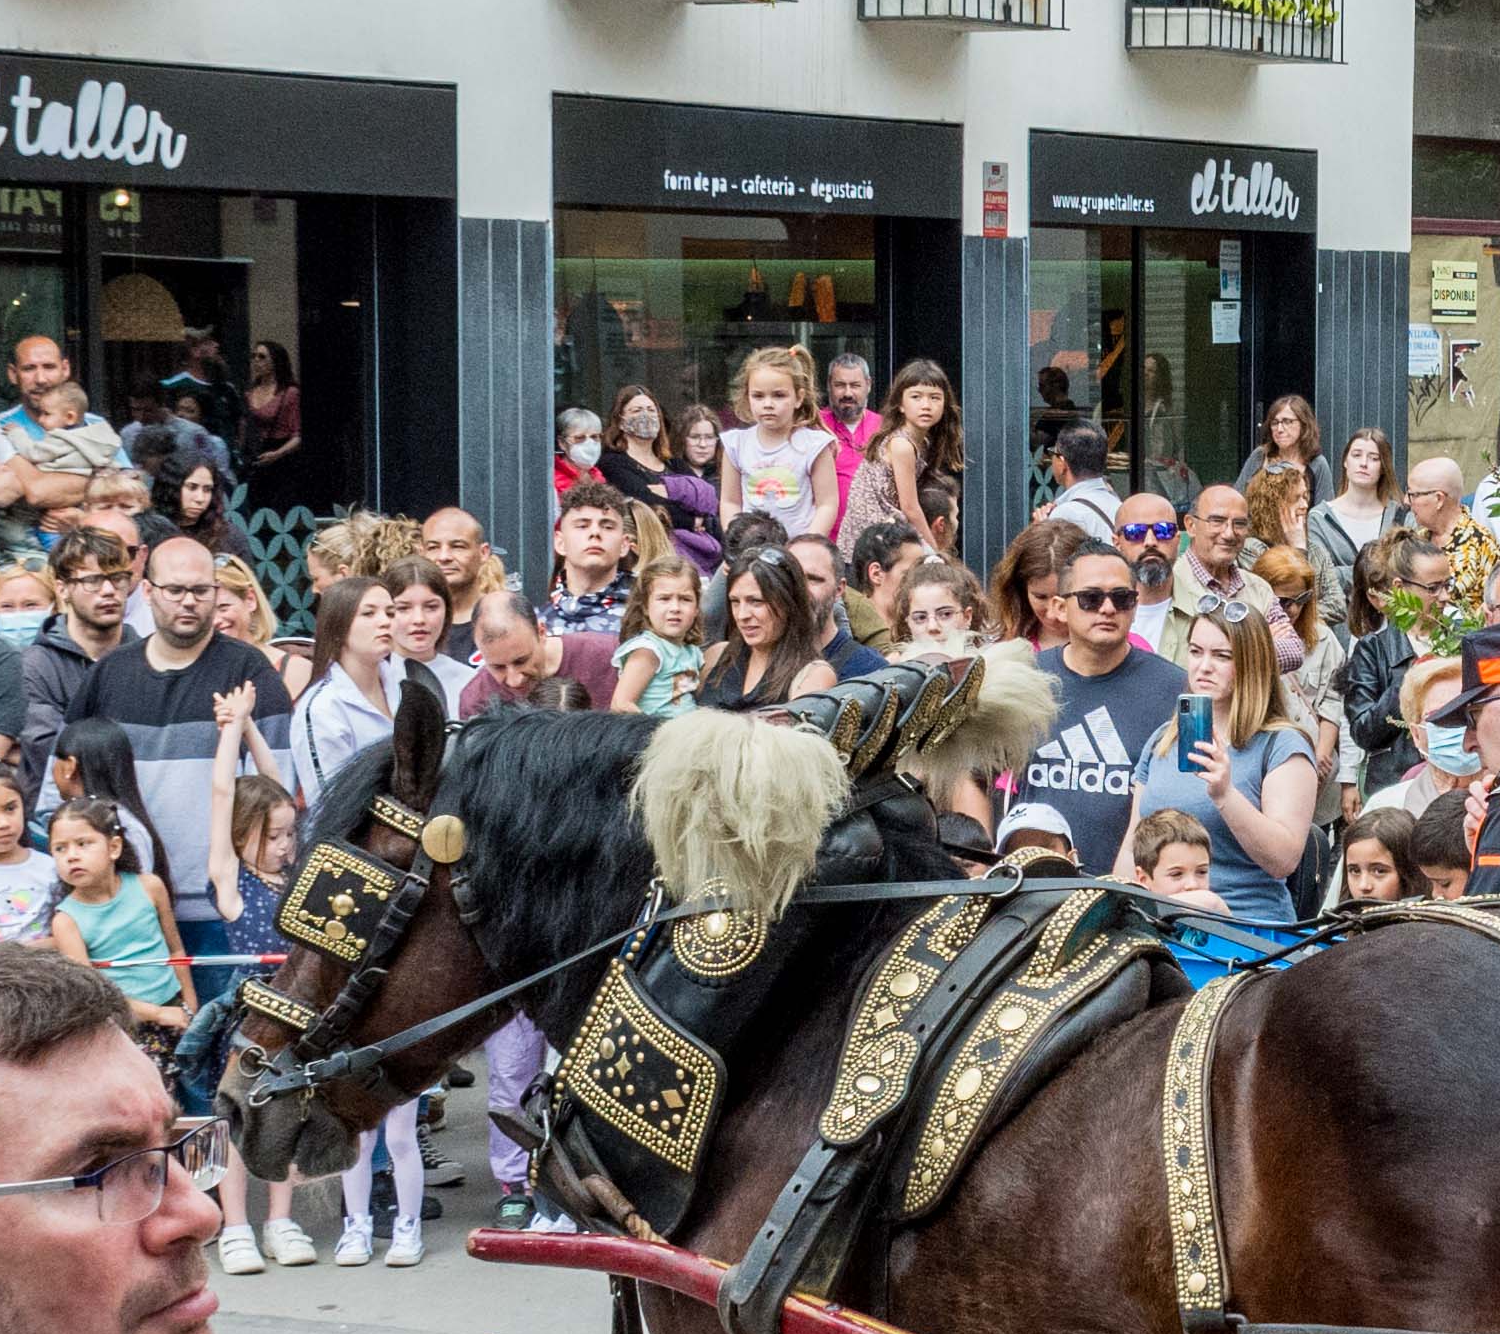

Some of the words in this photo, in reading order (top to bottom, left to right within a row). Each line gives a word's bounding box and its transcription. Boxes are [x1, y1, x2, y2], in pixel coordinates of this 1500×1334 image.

[10, 74, 188, 170] taller
[664, 169, 692, 192] forn
[693, 171, 710, 192] de
[711, 175, 728, 198] pa
[810, 178, 874, 204] degustació
[1190, 158, 1220, 216] el
[1220, 158, 1300, 221] taller
[1433, 288, 1476, 302] DISPONIBLE
